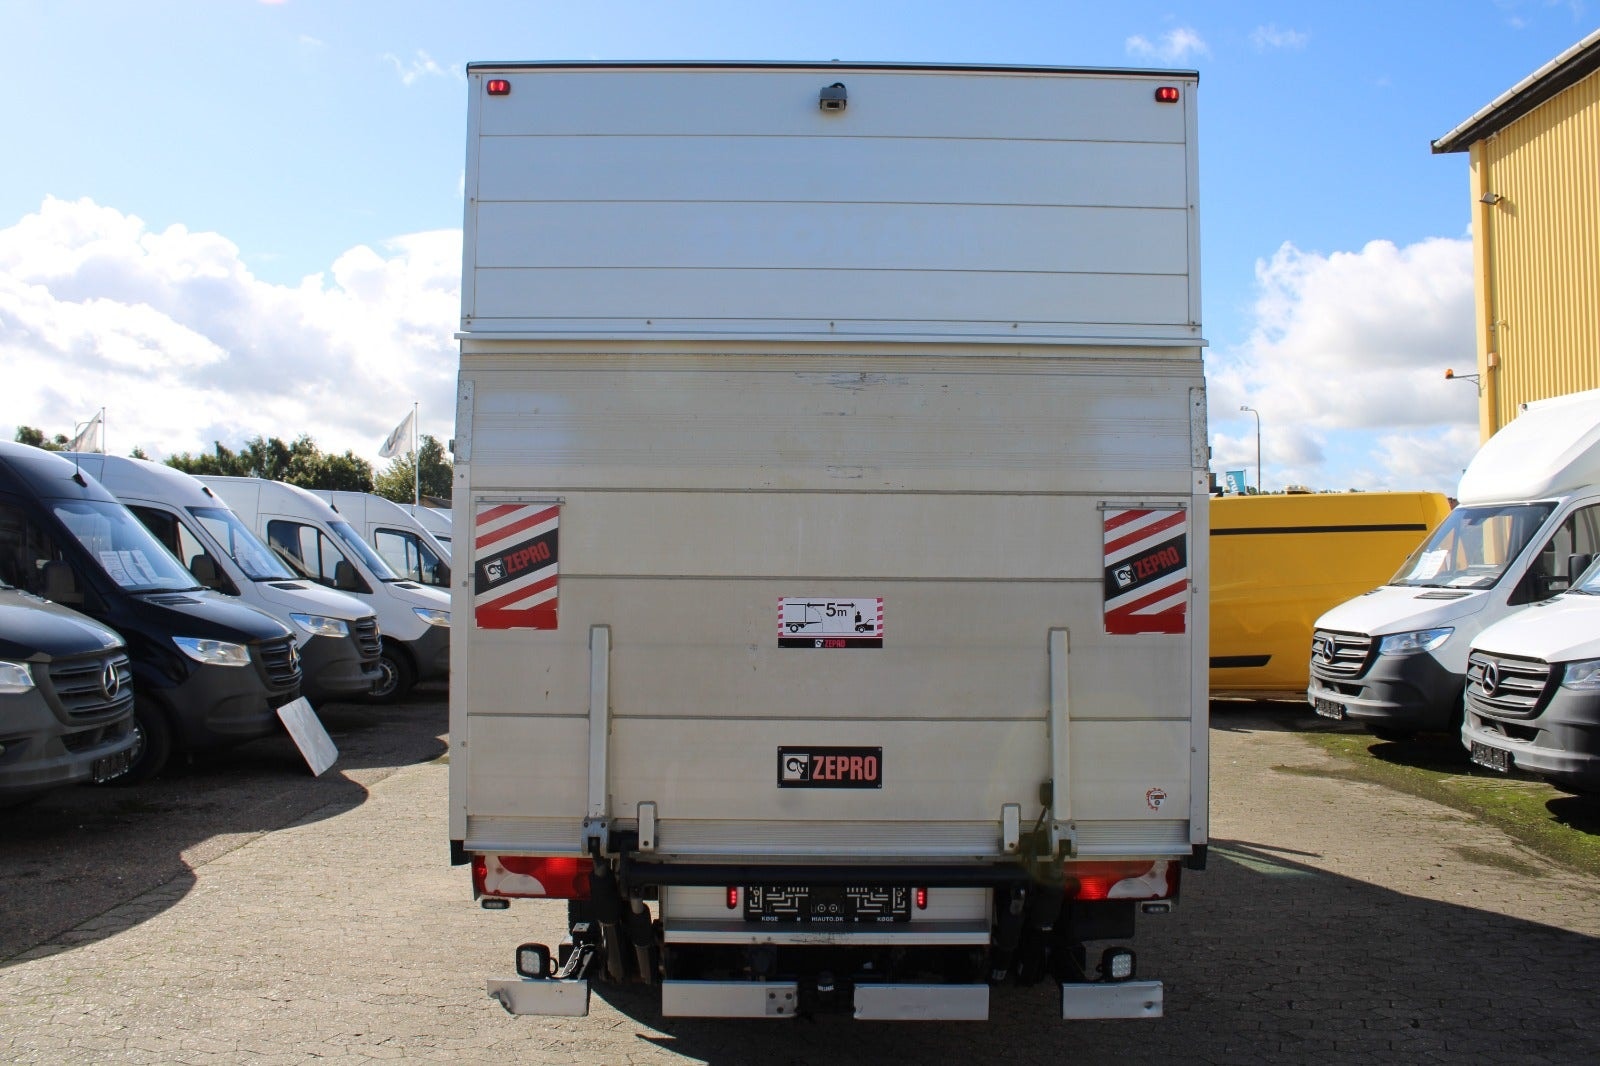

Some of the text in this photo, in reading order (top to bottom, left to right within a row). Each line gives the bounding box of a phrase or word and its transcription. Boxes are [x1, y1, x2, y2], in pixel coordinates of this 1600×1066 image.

[503, 540, 551, 574] ZEPRO
[1133, 545, 1181, 579] ZEPRO
[824, 639, 846, 648] ZEPRO
[812, 755, 877, 781] ZEPRO
